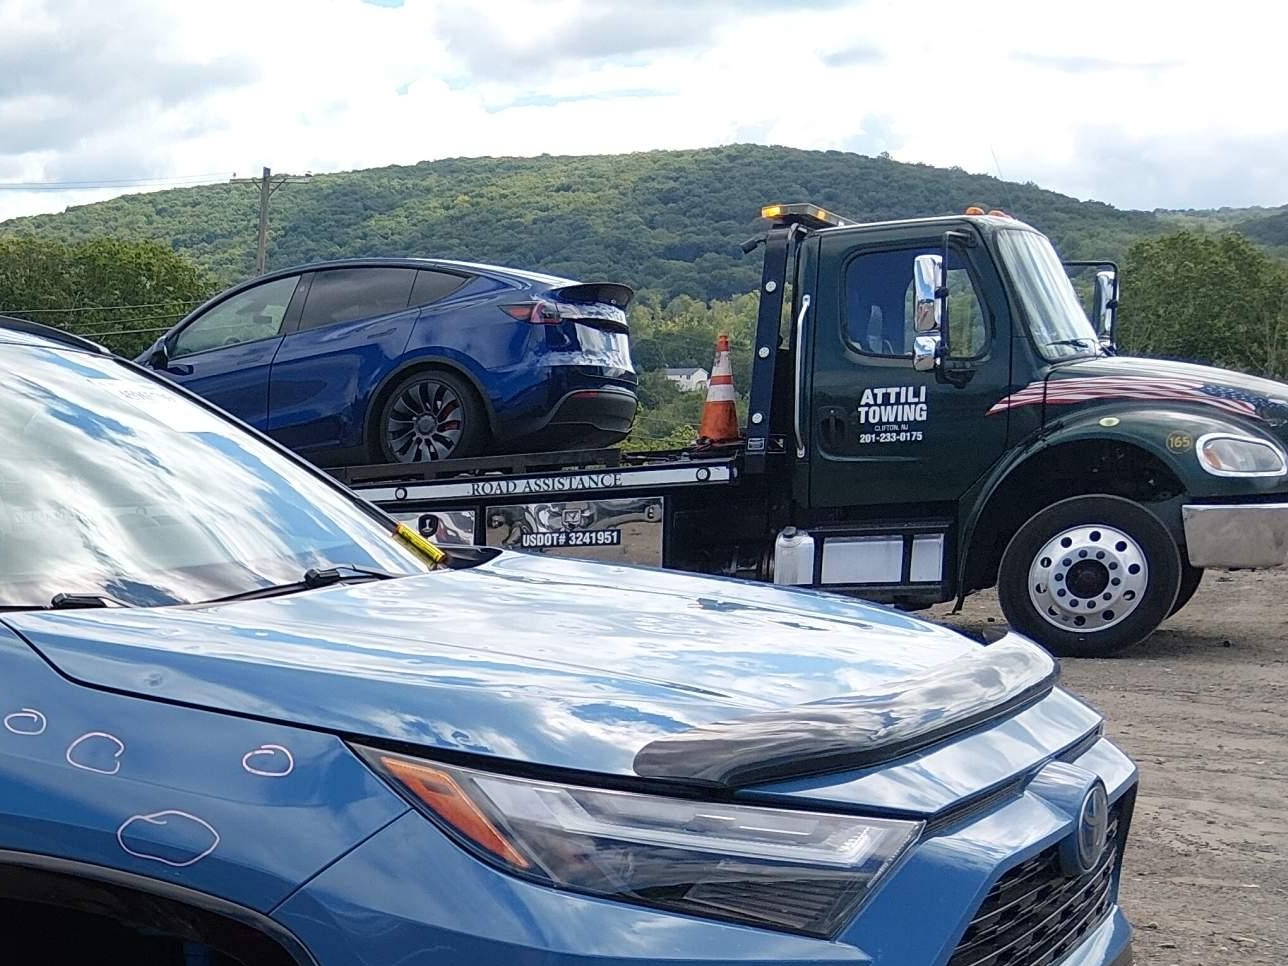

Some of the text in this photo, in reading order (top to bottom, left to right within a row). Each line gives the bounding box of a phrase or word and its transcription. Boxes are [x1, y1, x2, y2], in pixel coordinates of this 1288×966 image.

[860, 386, 926, 405] ATTILI
[858, 404, 928, 423] TOWING
[860, 432, 922, 443] 201-233-0175
[1170, 436, 1190, 448] 165
[471, 474, 622, 495] ROAD ASSISTANCE
[522, 530, 619, 547] USDOT# 3241951
